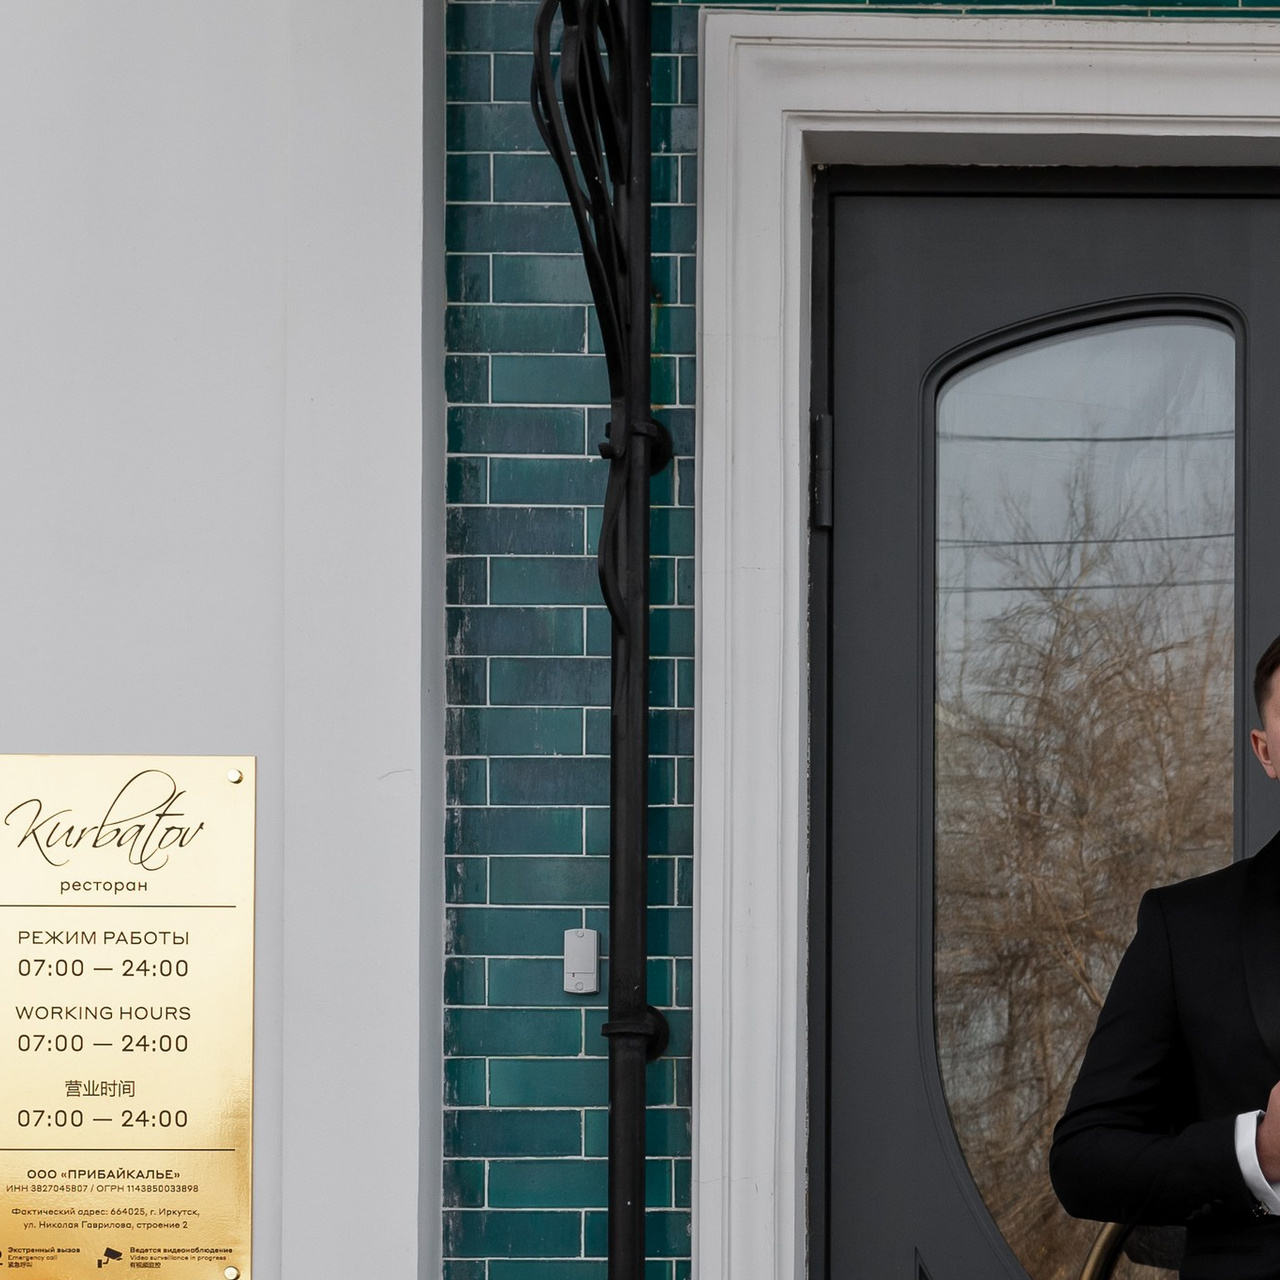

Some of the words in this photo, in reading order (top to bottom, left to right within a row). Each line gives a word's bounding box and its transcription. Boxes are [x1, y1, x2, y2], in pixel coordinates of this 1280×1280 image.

[4, 769, 205, 872] Kurbatov
[60, 881, 148, 895] ресторан
[18, 931, 97, 945] РЕЖИМ
[103, 931, 189, 945] РАБОТЫ
[18, 959, 84, 977] 07:00
[121, 959, 189, 977] 24:00
[15, 1006, 114, 1020] WORKING
[119, 1006, 192, 1021] HOURS
[17, 1034, 84, 1052] 07:00
[121, 1034, 188, 1052] 24:00
[65, 1080, 136, 1098] 营业时间
[17, 1110, 84, 1127] 07:00
[121, 1110, 188, 1128] 24:00
[27, 1169, 57, 1180] ООО
[61, 1167, 181, 1180] «ПРИБАЙКАЛЬЕ»
[6, 1184, 29, 1193] ИНН
[31, 1184, 88, 1193] 3827045807
[96, 1184, 125, 1193] ОГРН
[127, 1184, 199, 1193] 1143850033898
[11, 1207, 76, 1216] Фактический
[78, 1210, 109, 1218] адрес:
[110, 1208, 148, 1218] 664025,
[159, 1208, 200, 1218] Иркутск,
[23, 1223, 37, 1231] ул.
[39, 1221, 79, 1229] Николая
[81, 1221, 135, 1231] Гаврилова,
[137, 1222, 180, 1231] строение
[183, 1221, 189, 1229] 2
